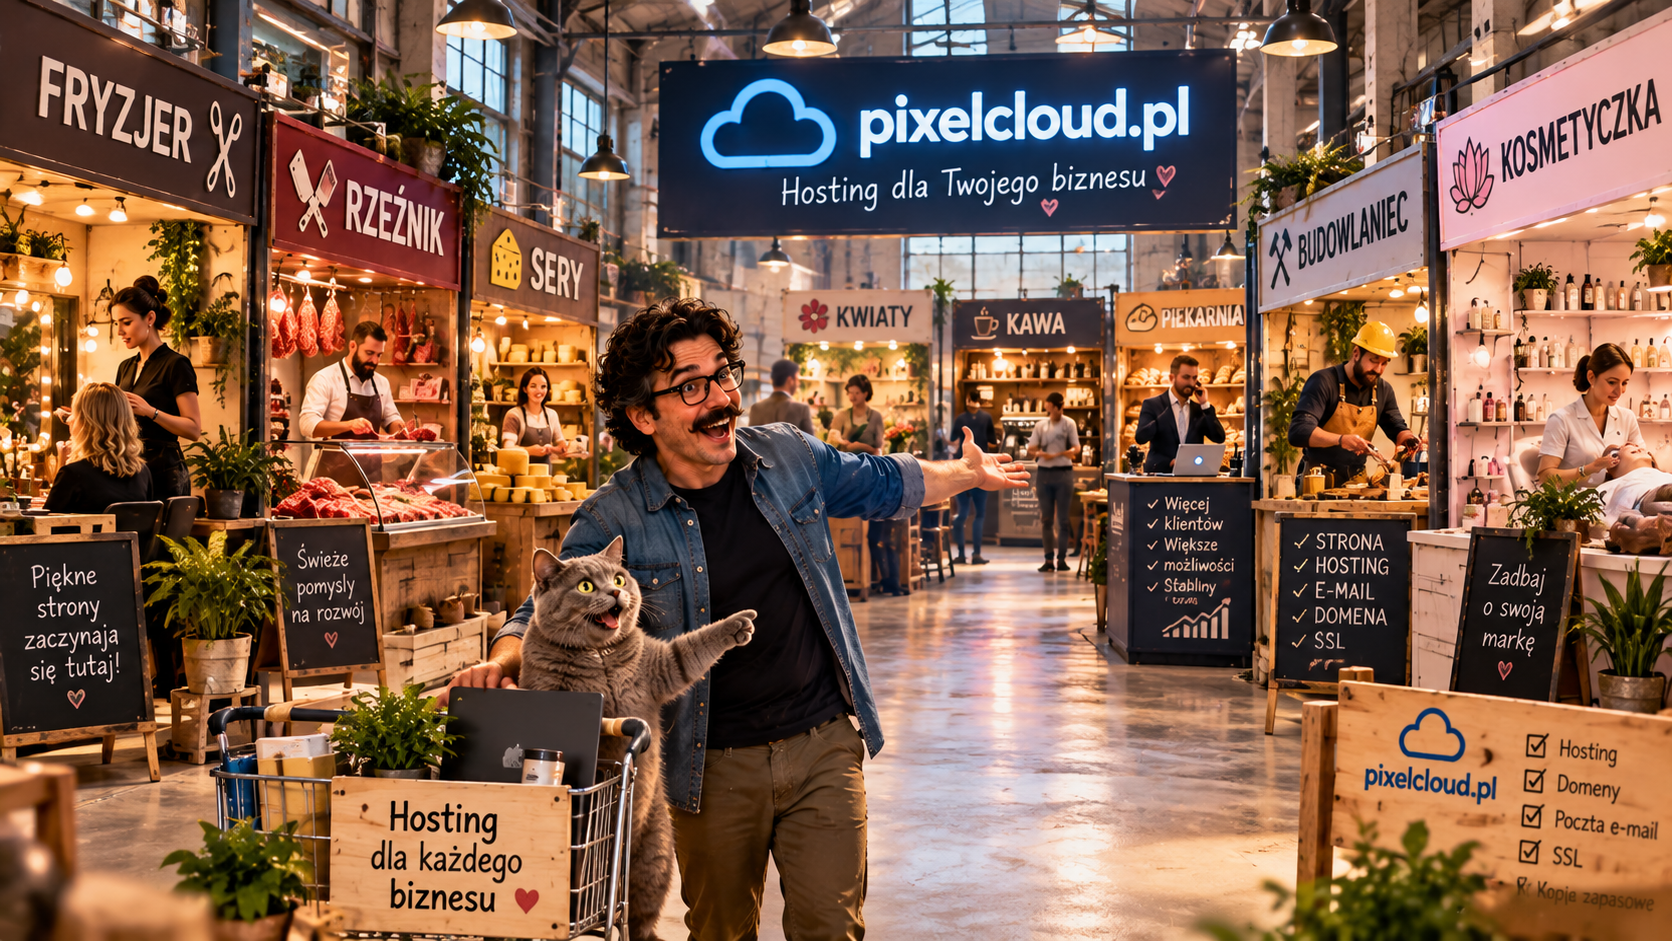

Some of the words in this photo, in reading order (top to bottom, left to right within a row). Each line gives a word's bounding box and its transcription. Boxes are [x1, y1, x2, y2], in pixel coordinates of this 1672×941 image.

[38, 55, 193, 164] FRYZJER
[858, 84, 1191, 159] pixelcloud.pl
[1500, 78, 1662, 183] KOSMETYCZKA
[781, 176, 878, 212] Hosting
[891, 168, 928, 199] dla
[940, 167, 1039, 206] Twojego
[1051, 162, 1146, 192] biznesu
[345, 179, 445, 257] RZEŹNIK
[1297, 190, 1410, 271] BUDOWLANIEC
[530, 246, 584, 301] SERY
[836, 305, 913, 328] KWIATY
[1006, 312, 1066, 335] KAWA
[1161, 304, 1245, 329] PIEKARNIA
[1164, 496, 1210, 515] Więcej
[1164, 515, 1224, 531] klientów
[297, 543, 349, 570] Świeże
[1164, 537, 1218, 555] Większe
[1316, 532, 1384, 551] STRONA
[30, 562, 97, 593] Piękne
[1315, 556, 1389, 576] HOSTING
[1488, 563, 1547, 596] Zadbaj
[1315, 581, 1375, 601] E-MAIL
[37, 595, 100, 623] strony
[291, 609, 310, 623] na
[316, 601, 365, 625] rozwój
[1314, 606, 1388, 626] DOMENA
[1483, 601, 1493, 616] o
[1314, 630, 1345, 650] SSL
[1482, 627, 1536, 658] markę
[30, 659, 56, 685] się
[64, 651, 121, 684] tutaj!
[1559, 738, 1618, 769] Hosting
[1364, 763, 1497, 804] pixelcloud.pl
[1557, 773, 1621, 805] Domeny
[390, 800, 498, 845] Hosting
[1554, 809, 1605, 834] Poczta
[1610, 821, 1659, 841] e-mail
[369, 839, 408, 871] dla
[419, 840, 523, 884] każdego
[1552, 845, 1583, 869] SSL
[390, 877, 496, 913] biznesu
